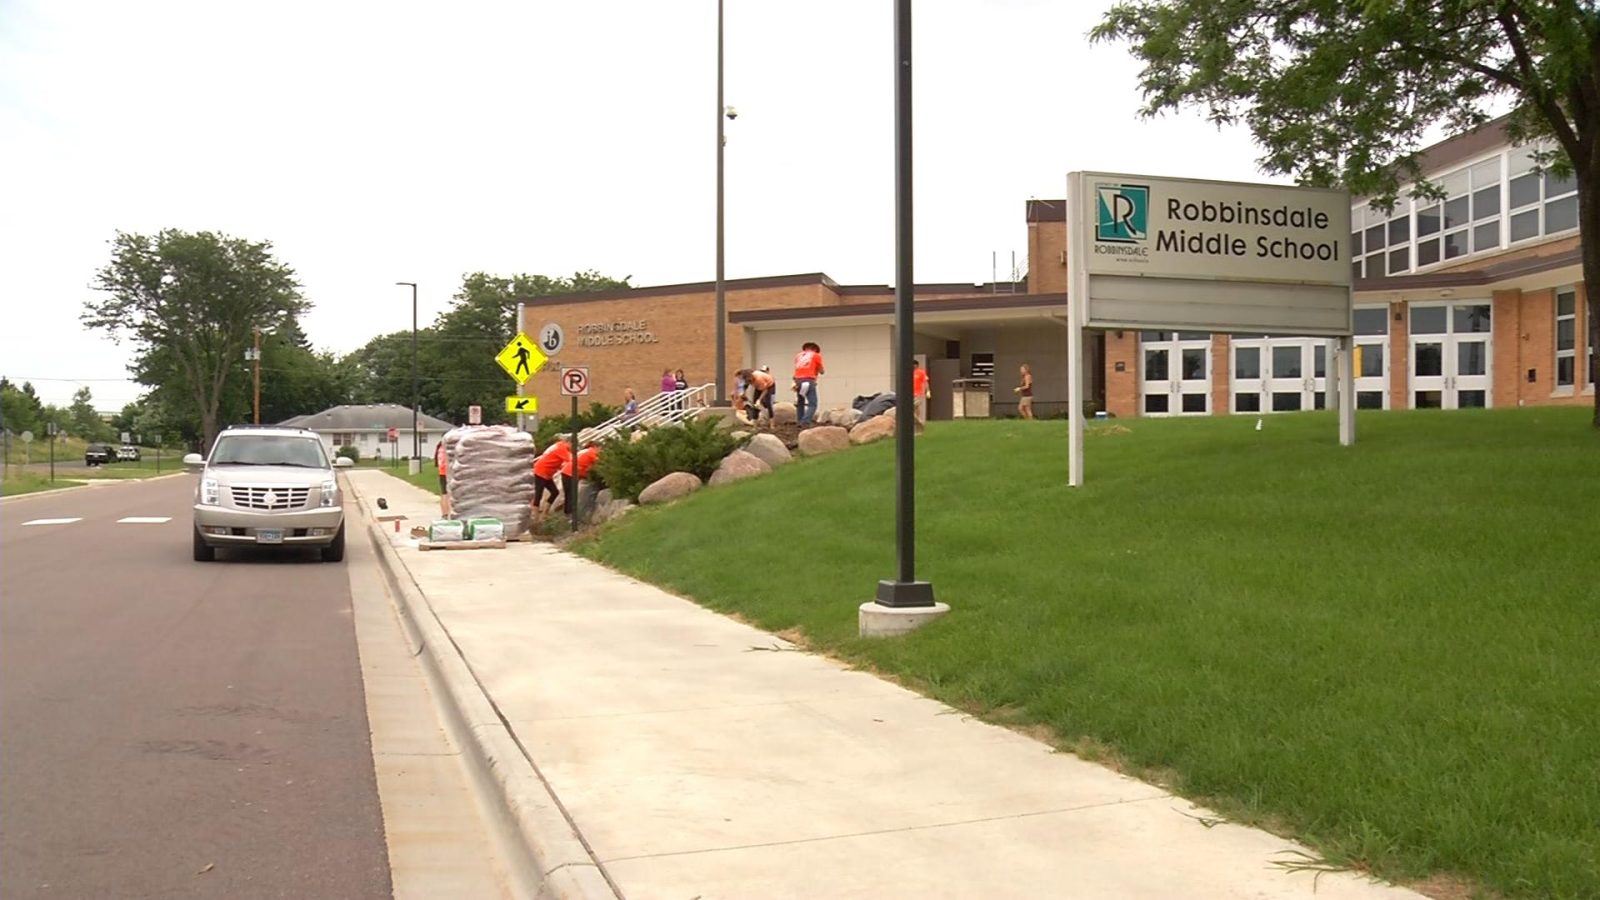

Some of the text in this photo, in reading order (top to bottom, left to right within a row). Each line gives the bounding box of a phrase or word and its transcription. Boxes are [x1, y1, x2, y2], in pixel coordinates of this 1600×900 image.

[1167, 198, 1329, 229] Robbinsdale
[1094, 244, 1149, 257] ROBBINSDALE
[1156, 229, 1339, 262] Middle School
[577, 332, 659, 348] MIDDLE SCHOOL
